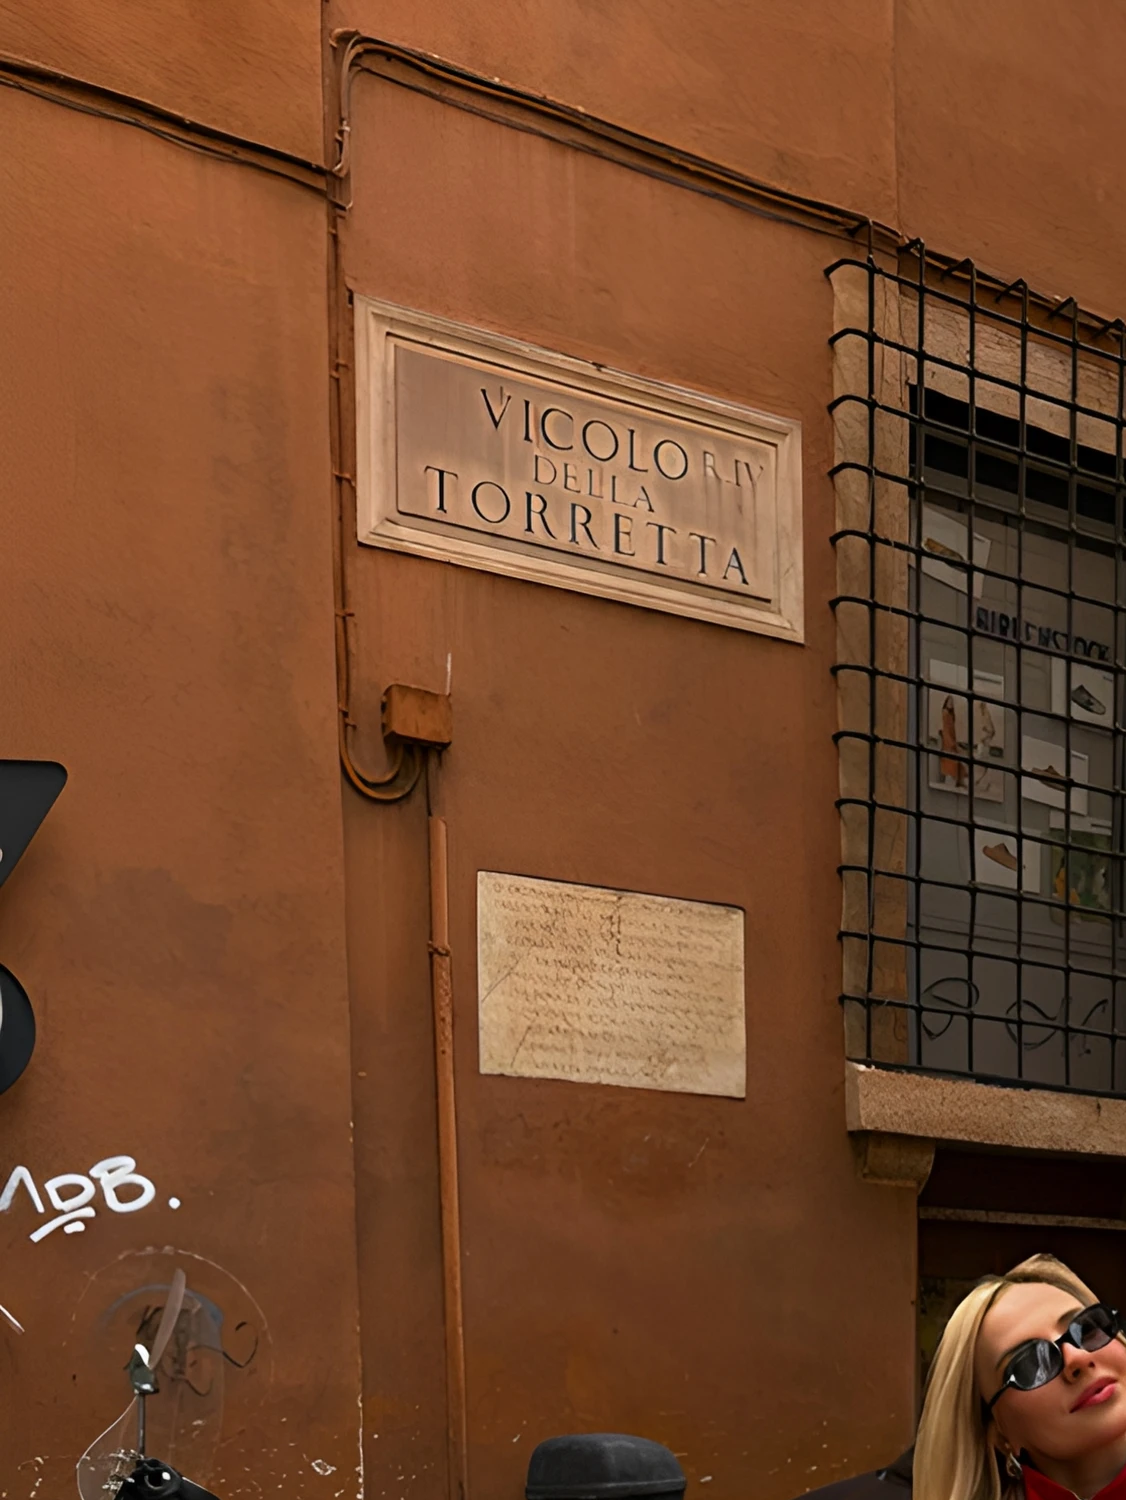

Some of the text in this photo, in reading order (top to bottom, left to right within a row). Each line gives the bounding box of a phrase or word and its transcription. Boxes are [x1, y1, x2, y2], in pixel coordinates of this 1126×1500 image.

[479, 387, 689, 481] VICOLO
[533, 454, 655, 512] DELLA
[424, 465, 749, 586] TORRETTA
[975, 605, 1111, 662] BIRENSOCK
